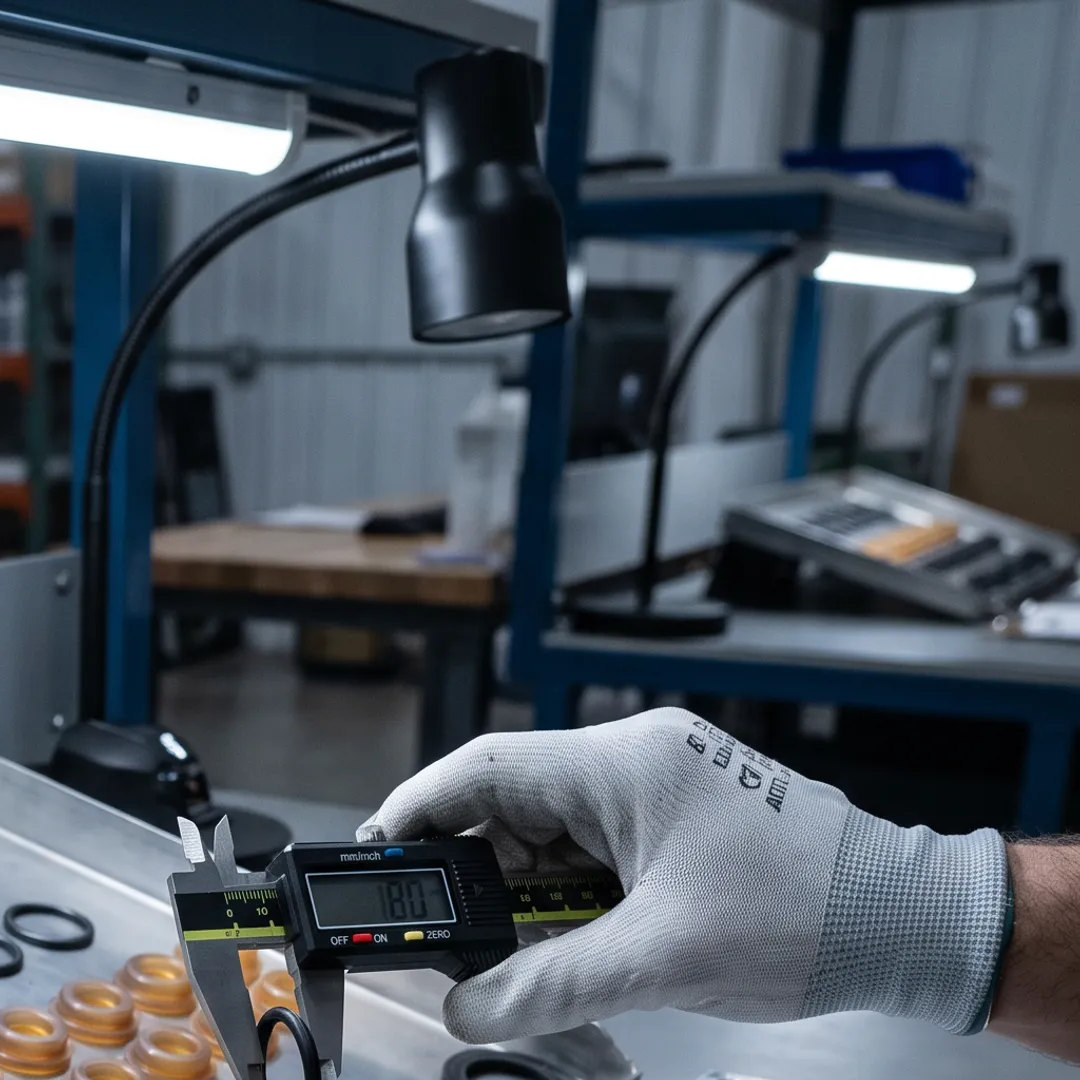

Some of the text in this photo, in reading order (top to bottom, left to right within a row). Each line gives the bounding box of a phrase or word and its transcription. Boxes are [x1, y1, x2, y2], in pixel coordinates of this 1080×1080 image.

[226, 908, 234, 918] 0
[256, 906, 269, 916] 10
[330, 935, 349, 946] OFF
[373, 933, 388, 944] ON
